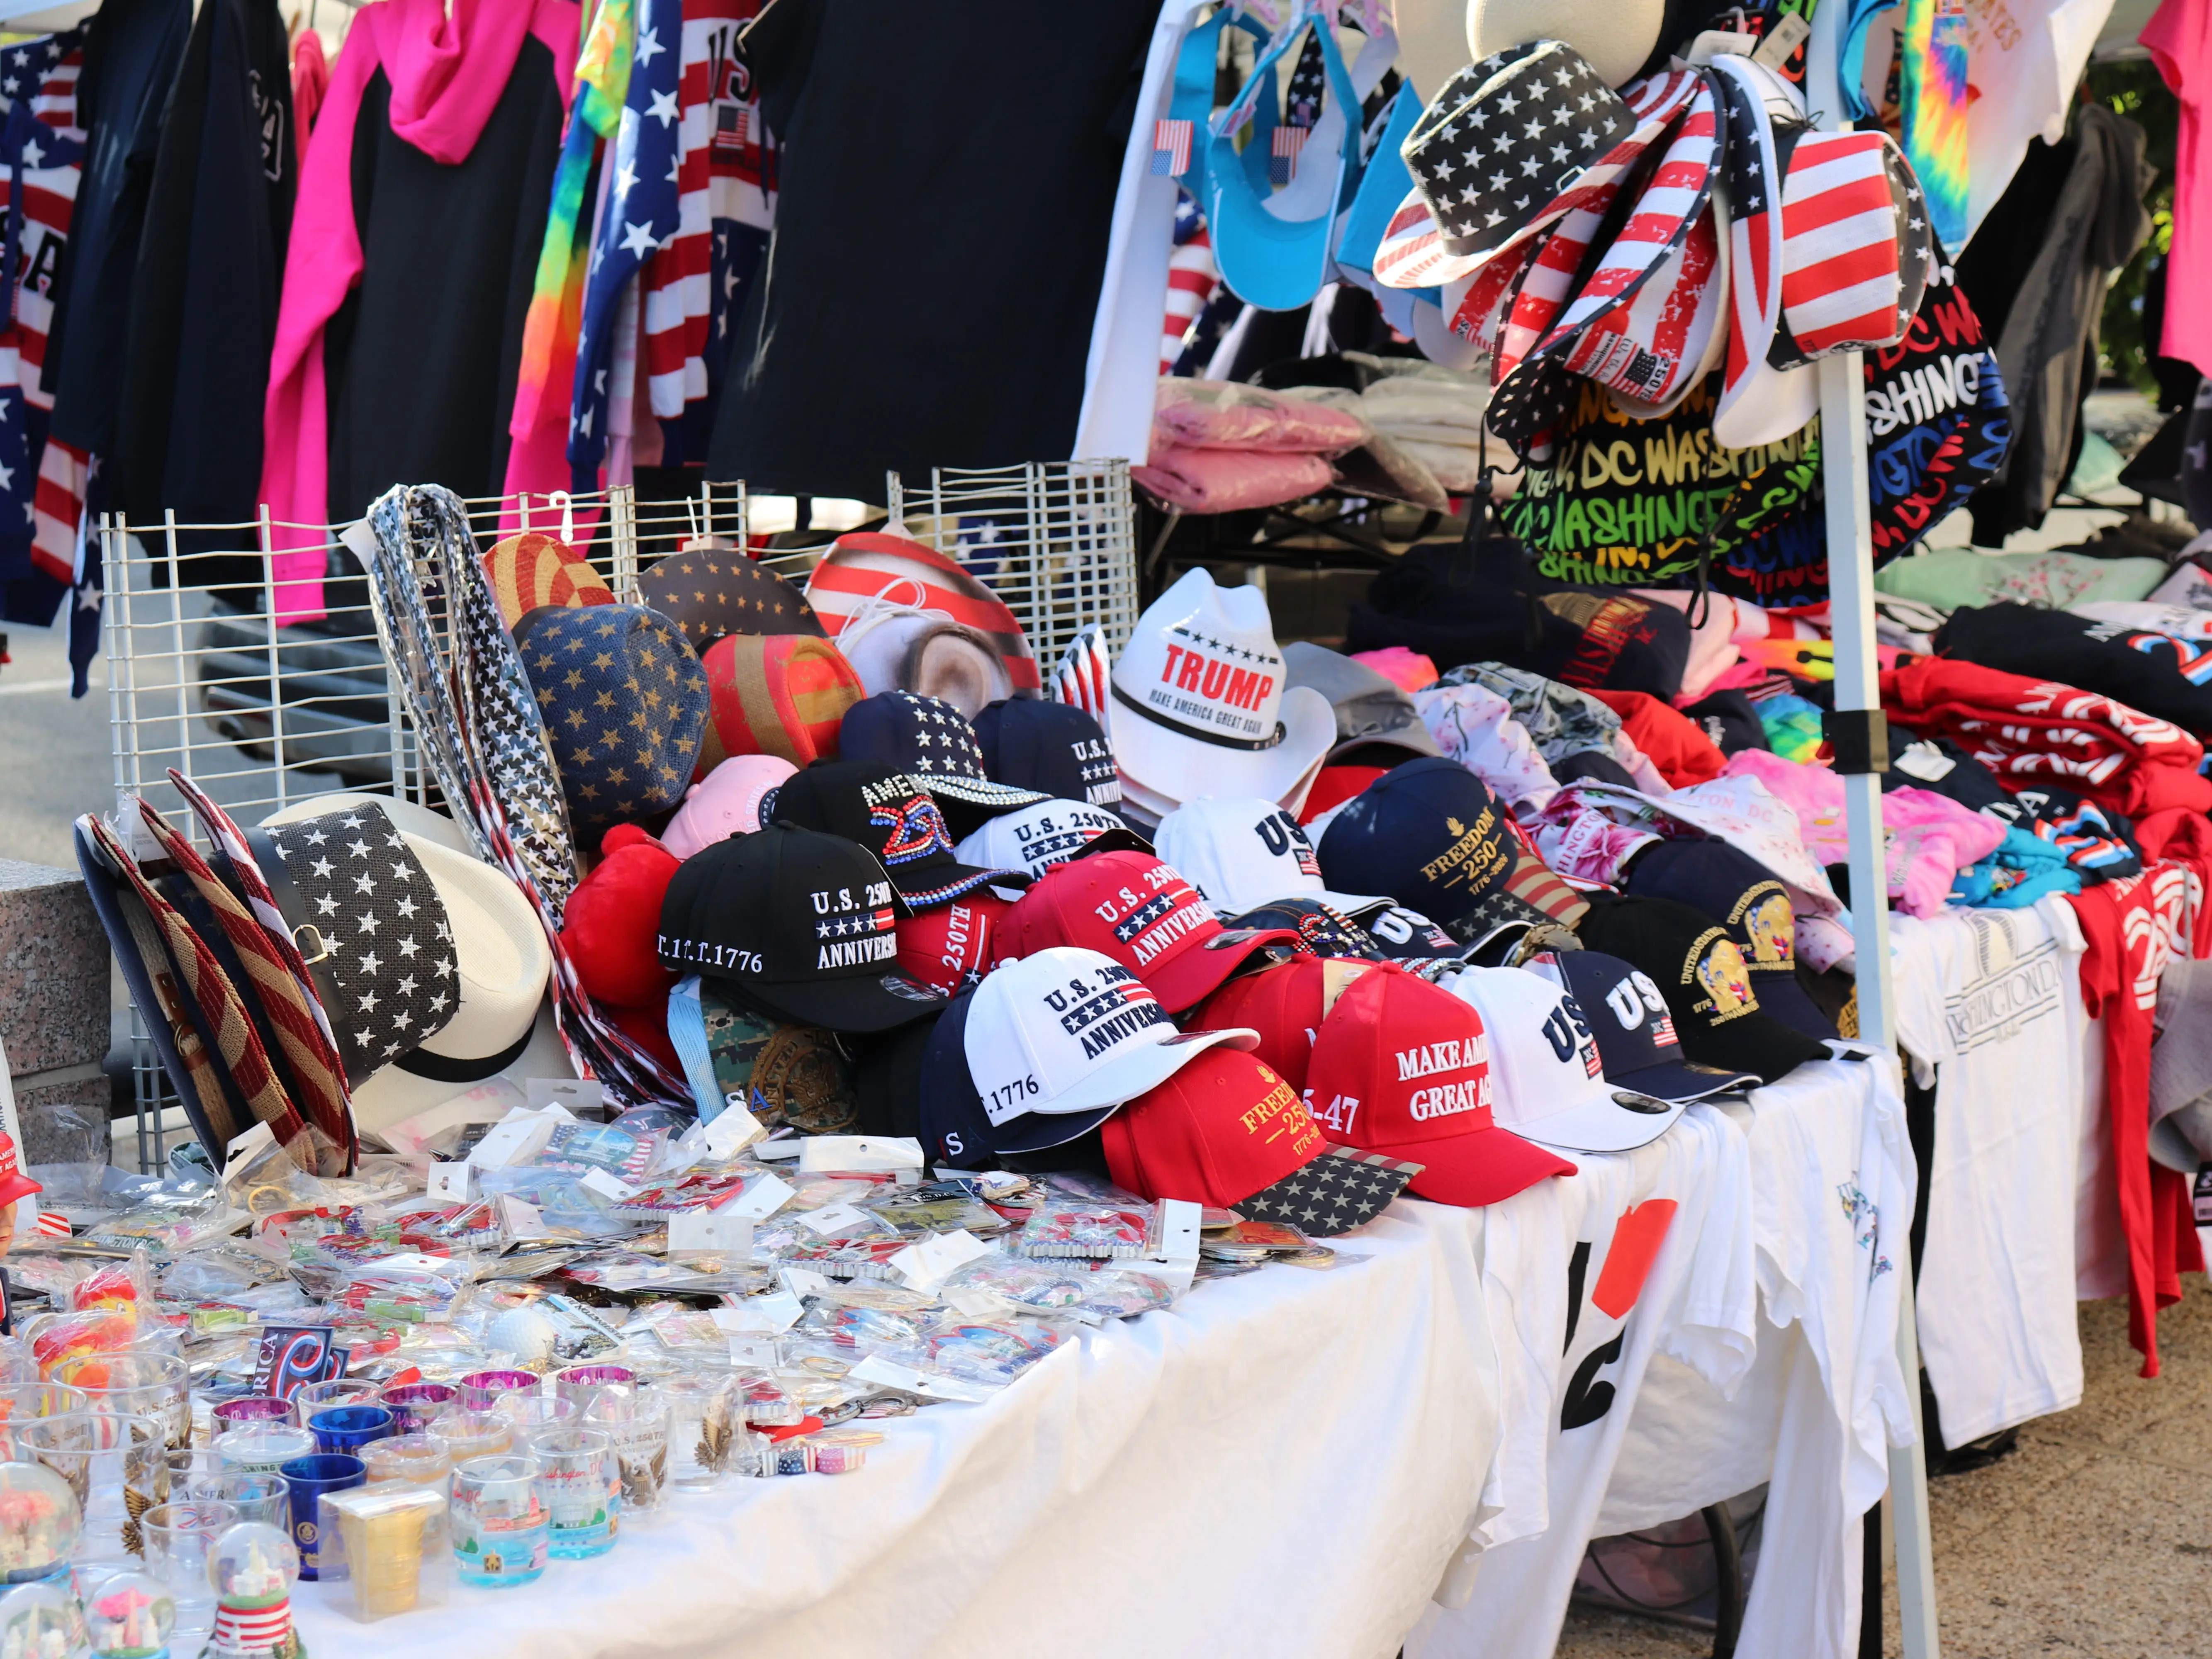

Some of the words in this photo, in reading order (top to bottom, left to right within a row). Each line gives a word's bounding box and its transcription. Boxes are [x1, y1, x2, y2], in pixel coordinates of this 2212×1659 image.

[1581, 439, 1643, 490] DC
[1161, 643, 1274, 712] TRUMP
[1149, 688, 1173, 708] MAKE
[1173, 697, 1215, 721] AMERICA
[1215, 710, 1243, 730] GREAT
[1242, 718, 1263, 735] AGAIN
[1071, 737, 1107, 761] U.S.
[1014, 815, 1064, 843] U.S.
[1420, 805, 1496, 882] FREEDOM
[1462, 840, 1497, 880] 250
[810, 888, 860, 914] U.S.
[1095, 886, 1147, 922] U.S.
[941, 903, 972, 971] 250TH
[1680, 946, 1702, 985] UNITED
[1044, 979, 1097, 1012] U.S.
[1692, 998, 1713, 1014] 1776
[1395, 1039, 1462, 1081] MAKE
[1410, 1080, 1477, 1122] GREAT
[251, 1333, 279, 1397] RICA
[613, 1435, 634, 1447] U.S.
